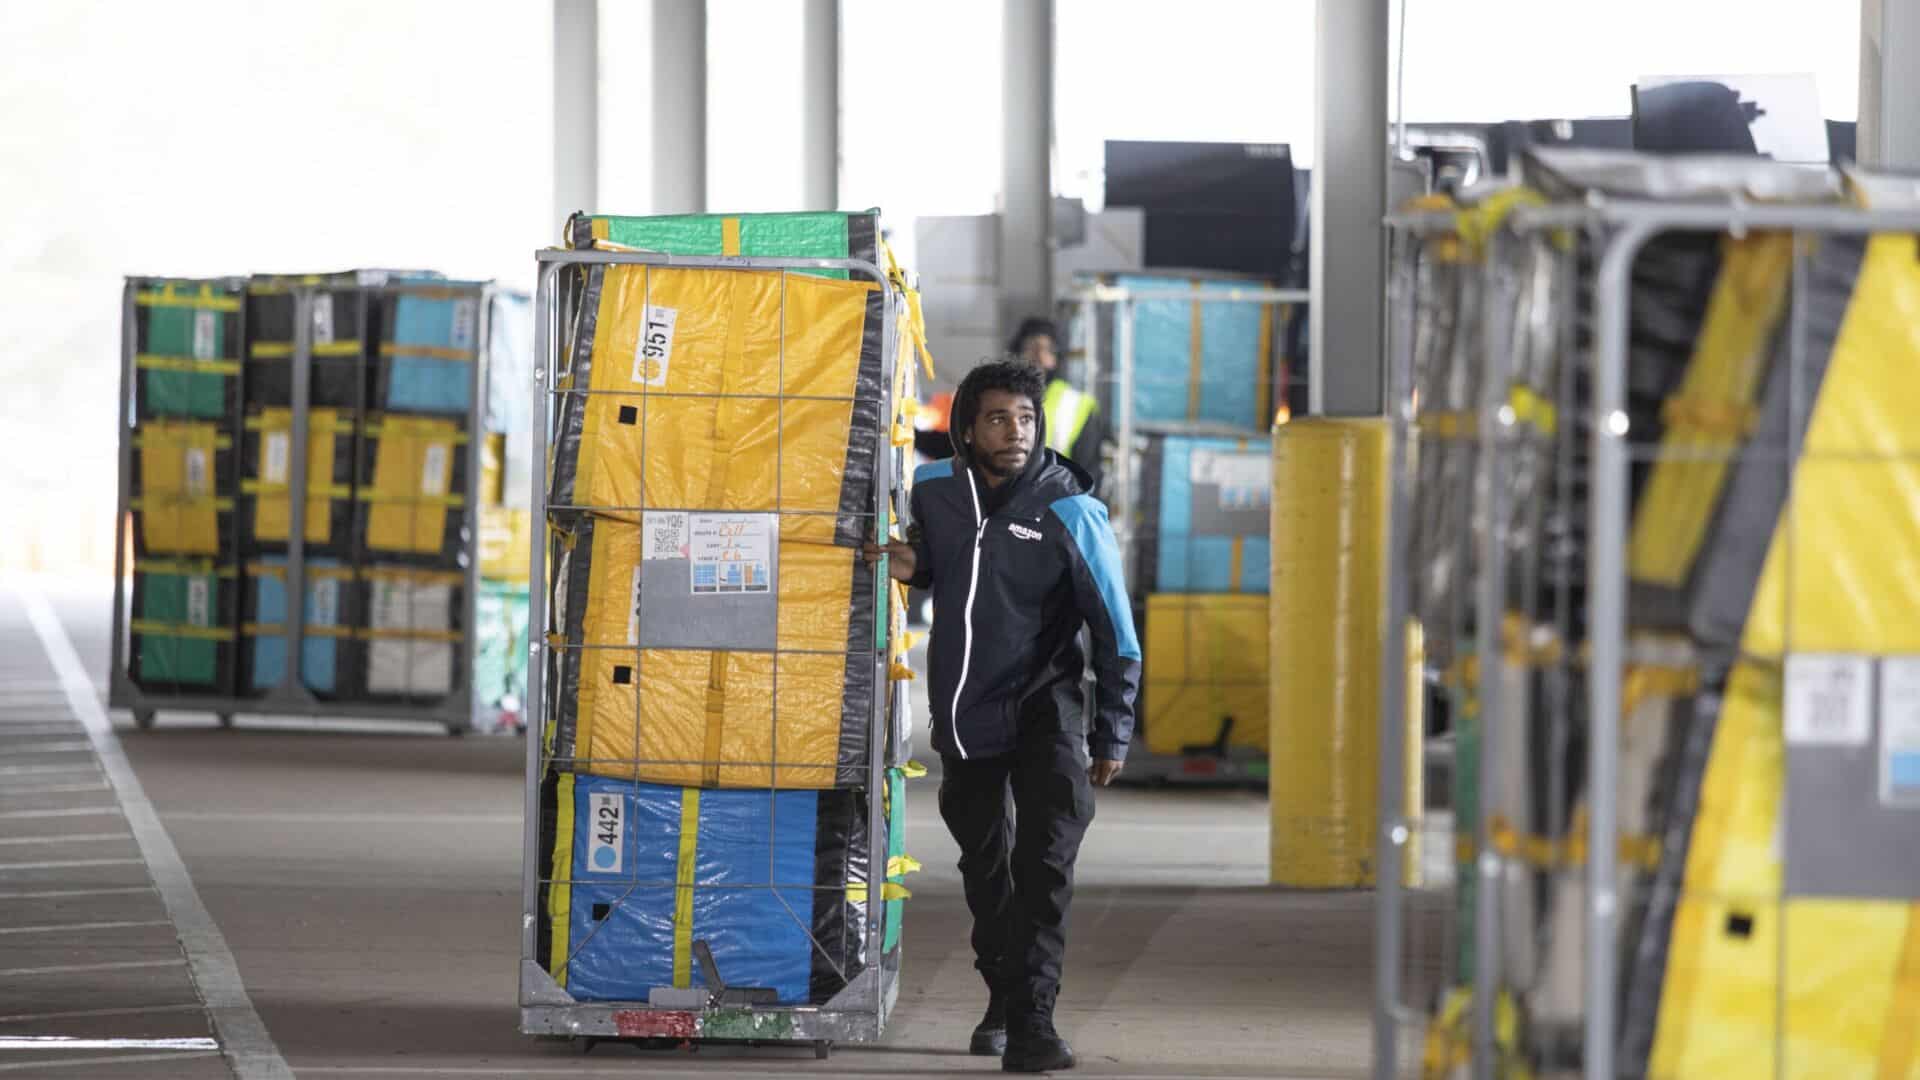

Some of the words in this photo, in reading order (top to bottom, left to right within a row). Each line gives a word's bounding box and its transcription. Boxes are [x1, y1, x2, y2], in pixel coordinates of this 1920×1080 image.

[642, 321, 668, 358] 951
[1008, 523, 1043, 541] amazon
[598, 807, 619, 845] 442
